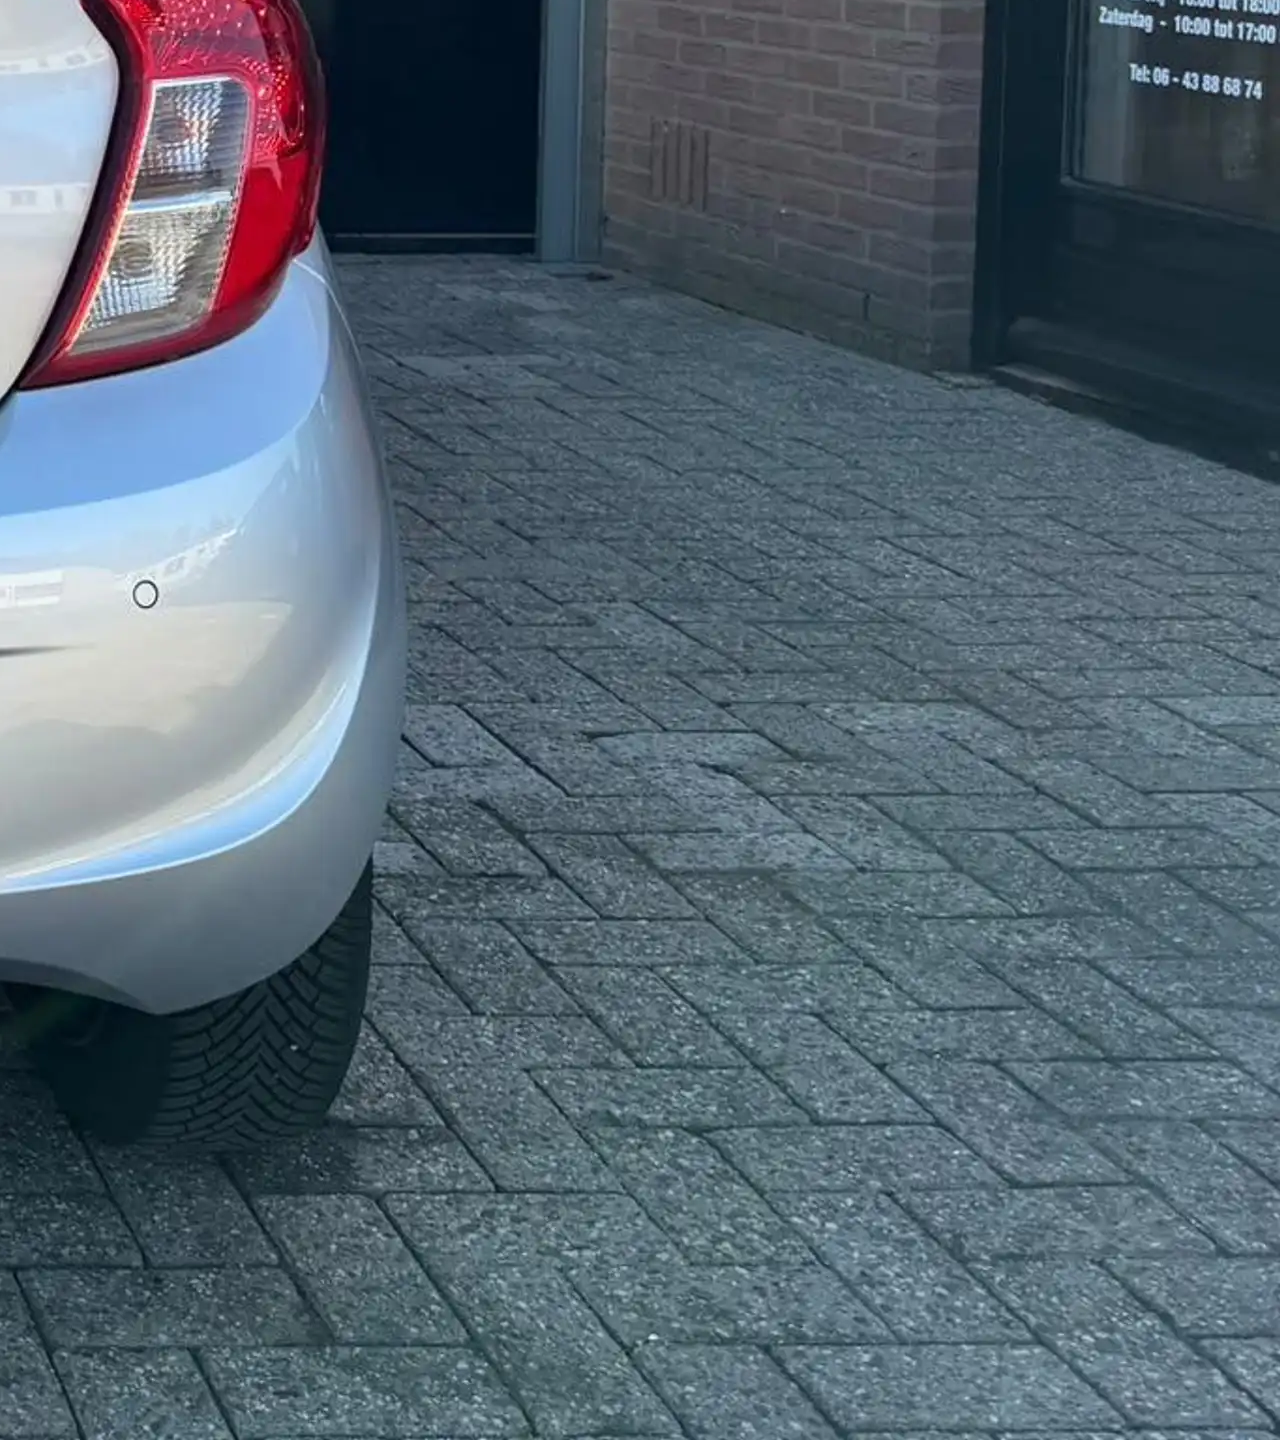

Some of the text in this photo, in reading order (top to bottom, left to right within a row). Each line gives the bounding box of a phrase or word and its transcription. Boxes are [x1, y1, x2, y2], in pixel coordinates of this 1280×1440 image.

[1099, 6, 1154, 33] Zaterdag
[1174, 15, 1211, 36] 10:00
[1214, 19, 1233, 39] tot
[1236, 21, 1277, 44] 17:00
[1129, 63, 1150, 83] Tel:
[1152, 66, 1170, 86] 06
[1182, 71, 1199, 91] 43
[1244, 80, 1263, 100] 74
